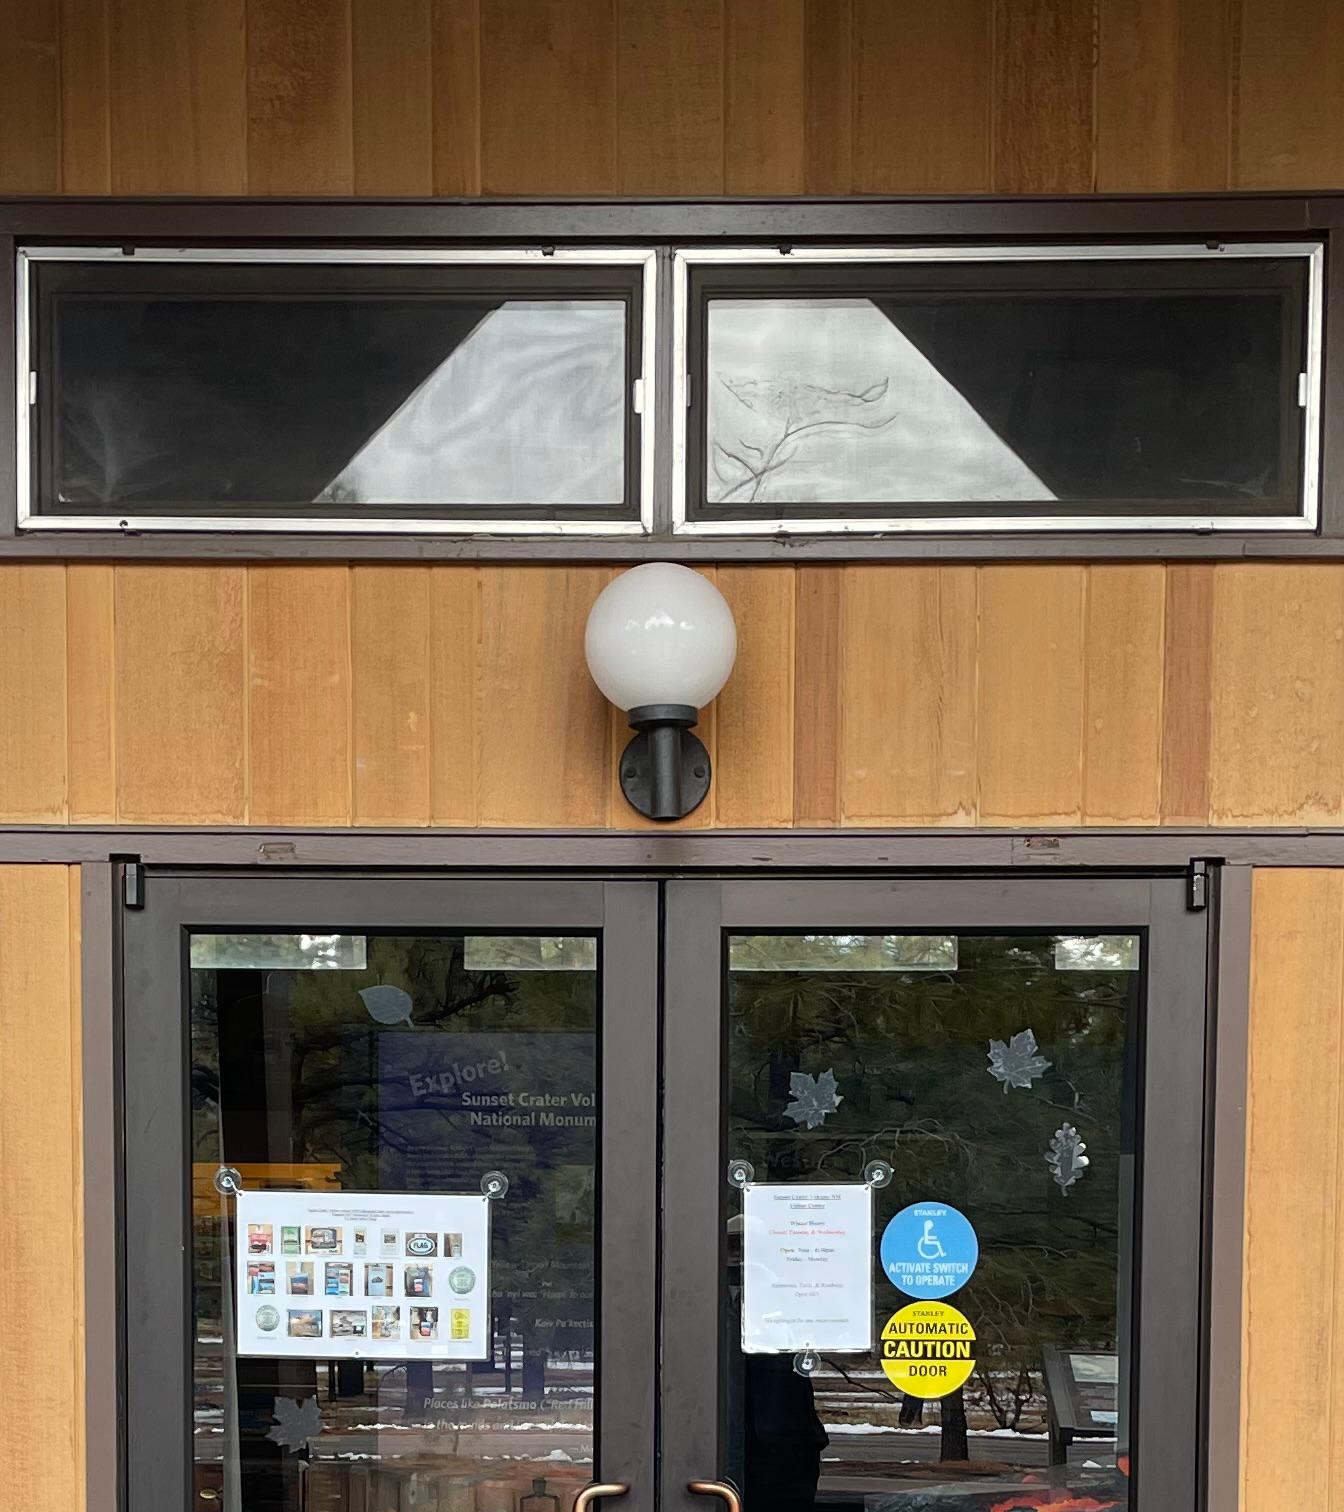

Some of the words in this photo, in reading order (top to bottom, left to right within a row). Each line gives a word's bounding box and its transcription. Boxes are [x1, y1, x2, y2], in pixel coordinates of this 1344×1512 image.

[408, 1050, 510, 1097] Explore!
[461, 1092, 515, 1107] Sunset
[519, 1092, 567, 1107] Crater
[470, 1112, 536, 1127] National
[888, 1262, 931, 1274] ACTIVATE
[932, 1262, 969, 1274] SWITCH
[901, 1275, 914, 1286] TO
[915, 1275, 956, 1286] OPERATE
[888, 1322, 969, 1335] AUTOMATIC
[883, 1340, 971, 1358] CAUTION
[908, 1365, 948, 1377] DOOR
[423, 1397, 458, 1410] Places
